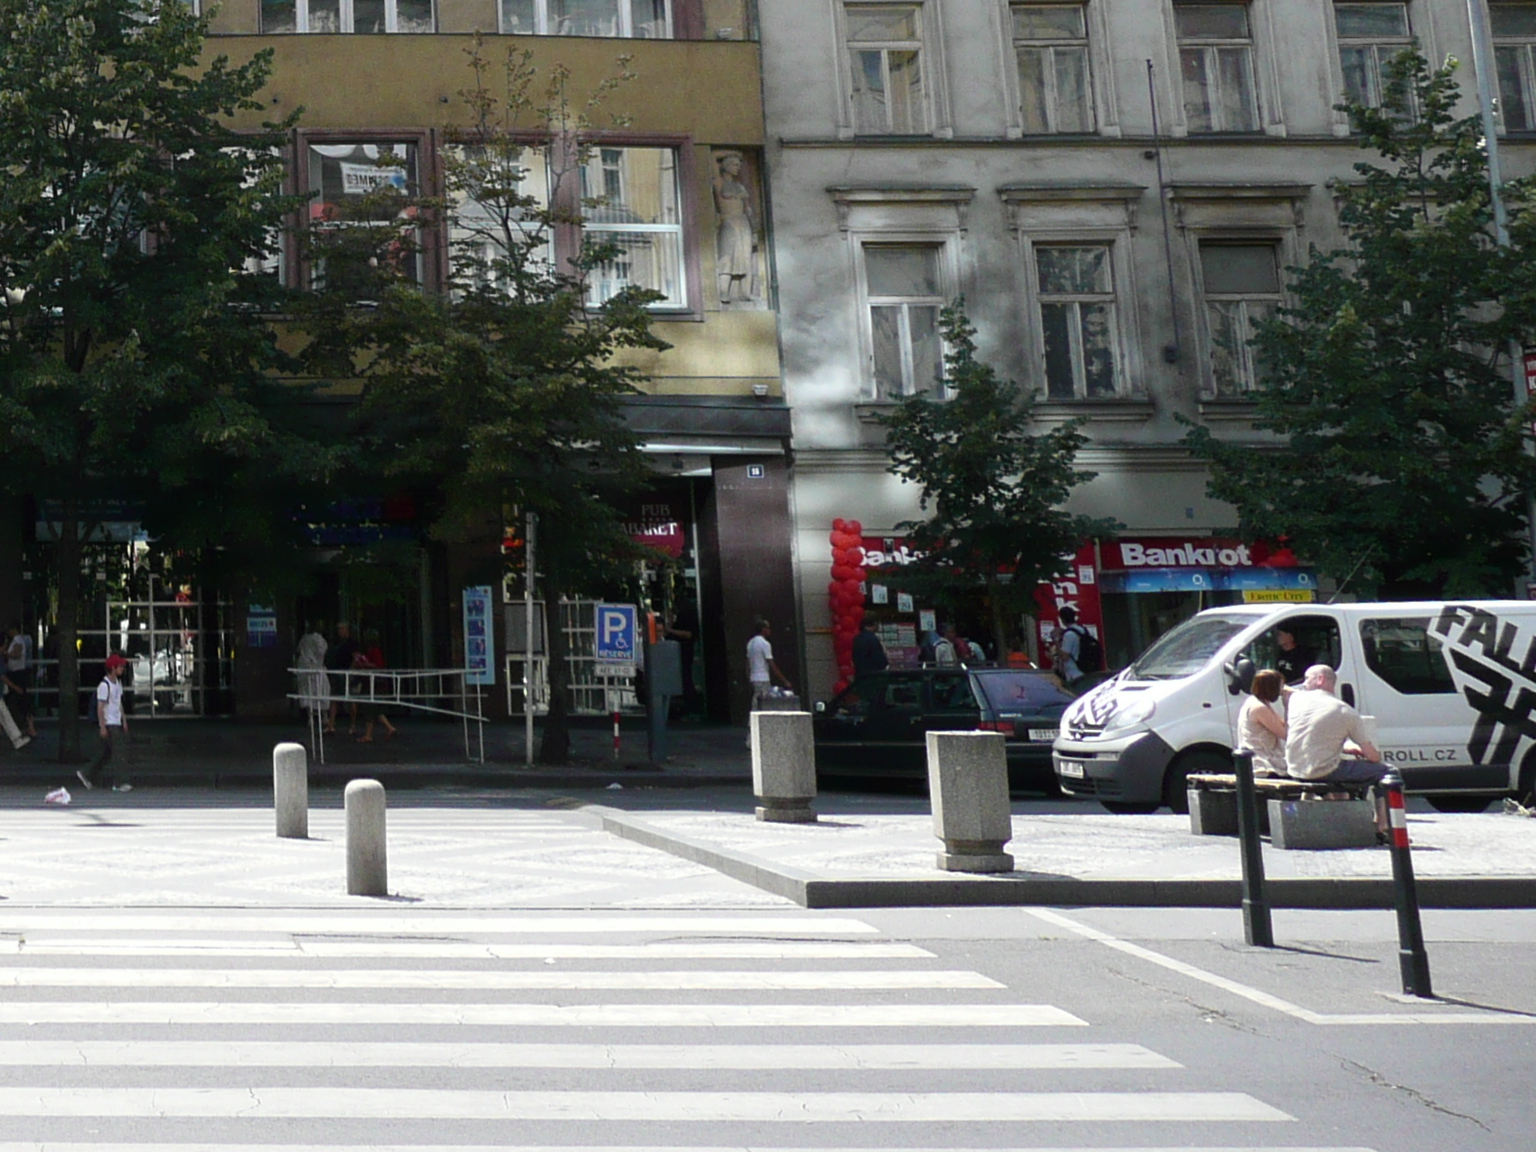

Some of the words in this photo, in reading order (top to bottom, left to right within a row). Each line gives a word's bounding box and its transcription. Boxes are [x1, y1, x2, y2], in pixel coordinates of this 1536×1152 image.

[641, 504, 672, 517] PUB
[619, 522, 678, 536] ABARET
[1119, 542, 1253, 566] Bankrot
[603, 611, 627, 644] P
